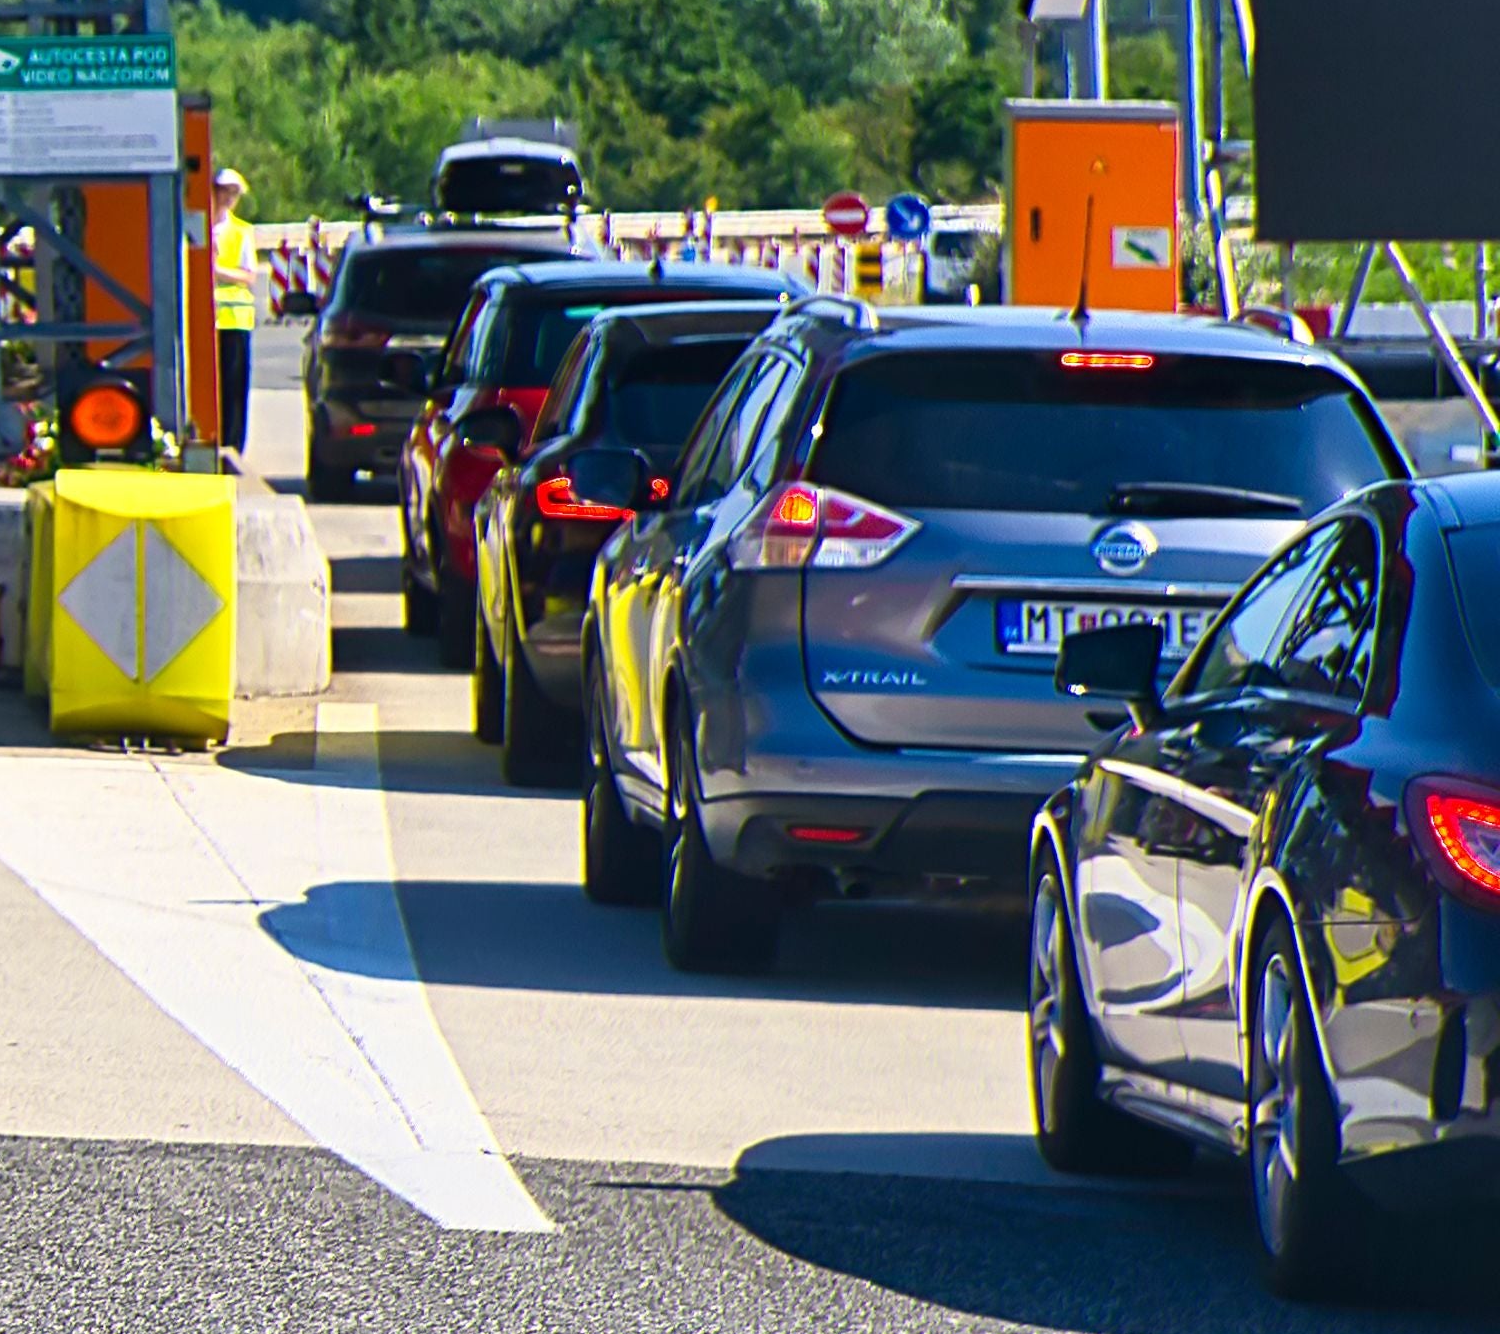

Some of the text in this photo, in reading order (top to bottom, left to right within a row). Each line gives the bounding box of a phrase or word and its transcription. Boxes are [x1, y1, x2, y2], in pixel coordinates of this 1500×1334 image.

[27, 46, 169, 65] AUTOCESTA POD
[20, 67, 169, 84] VIDEO NADZOROM
